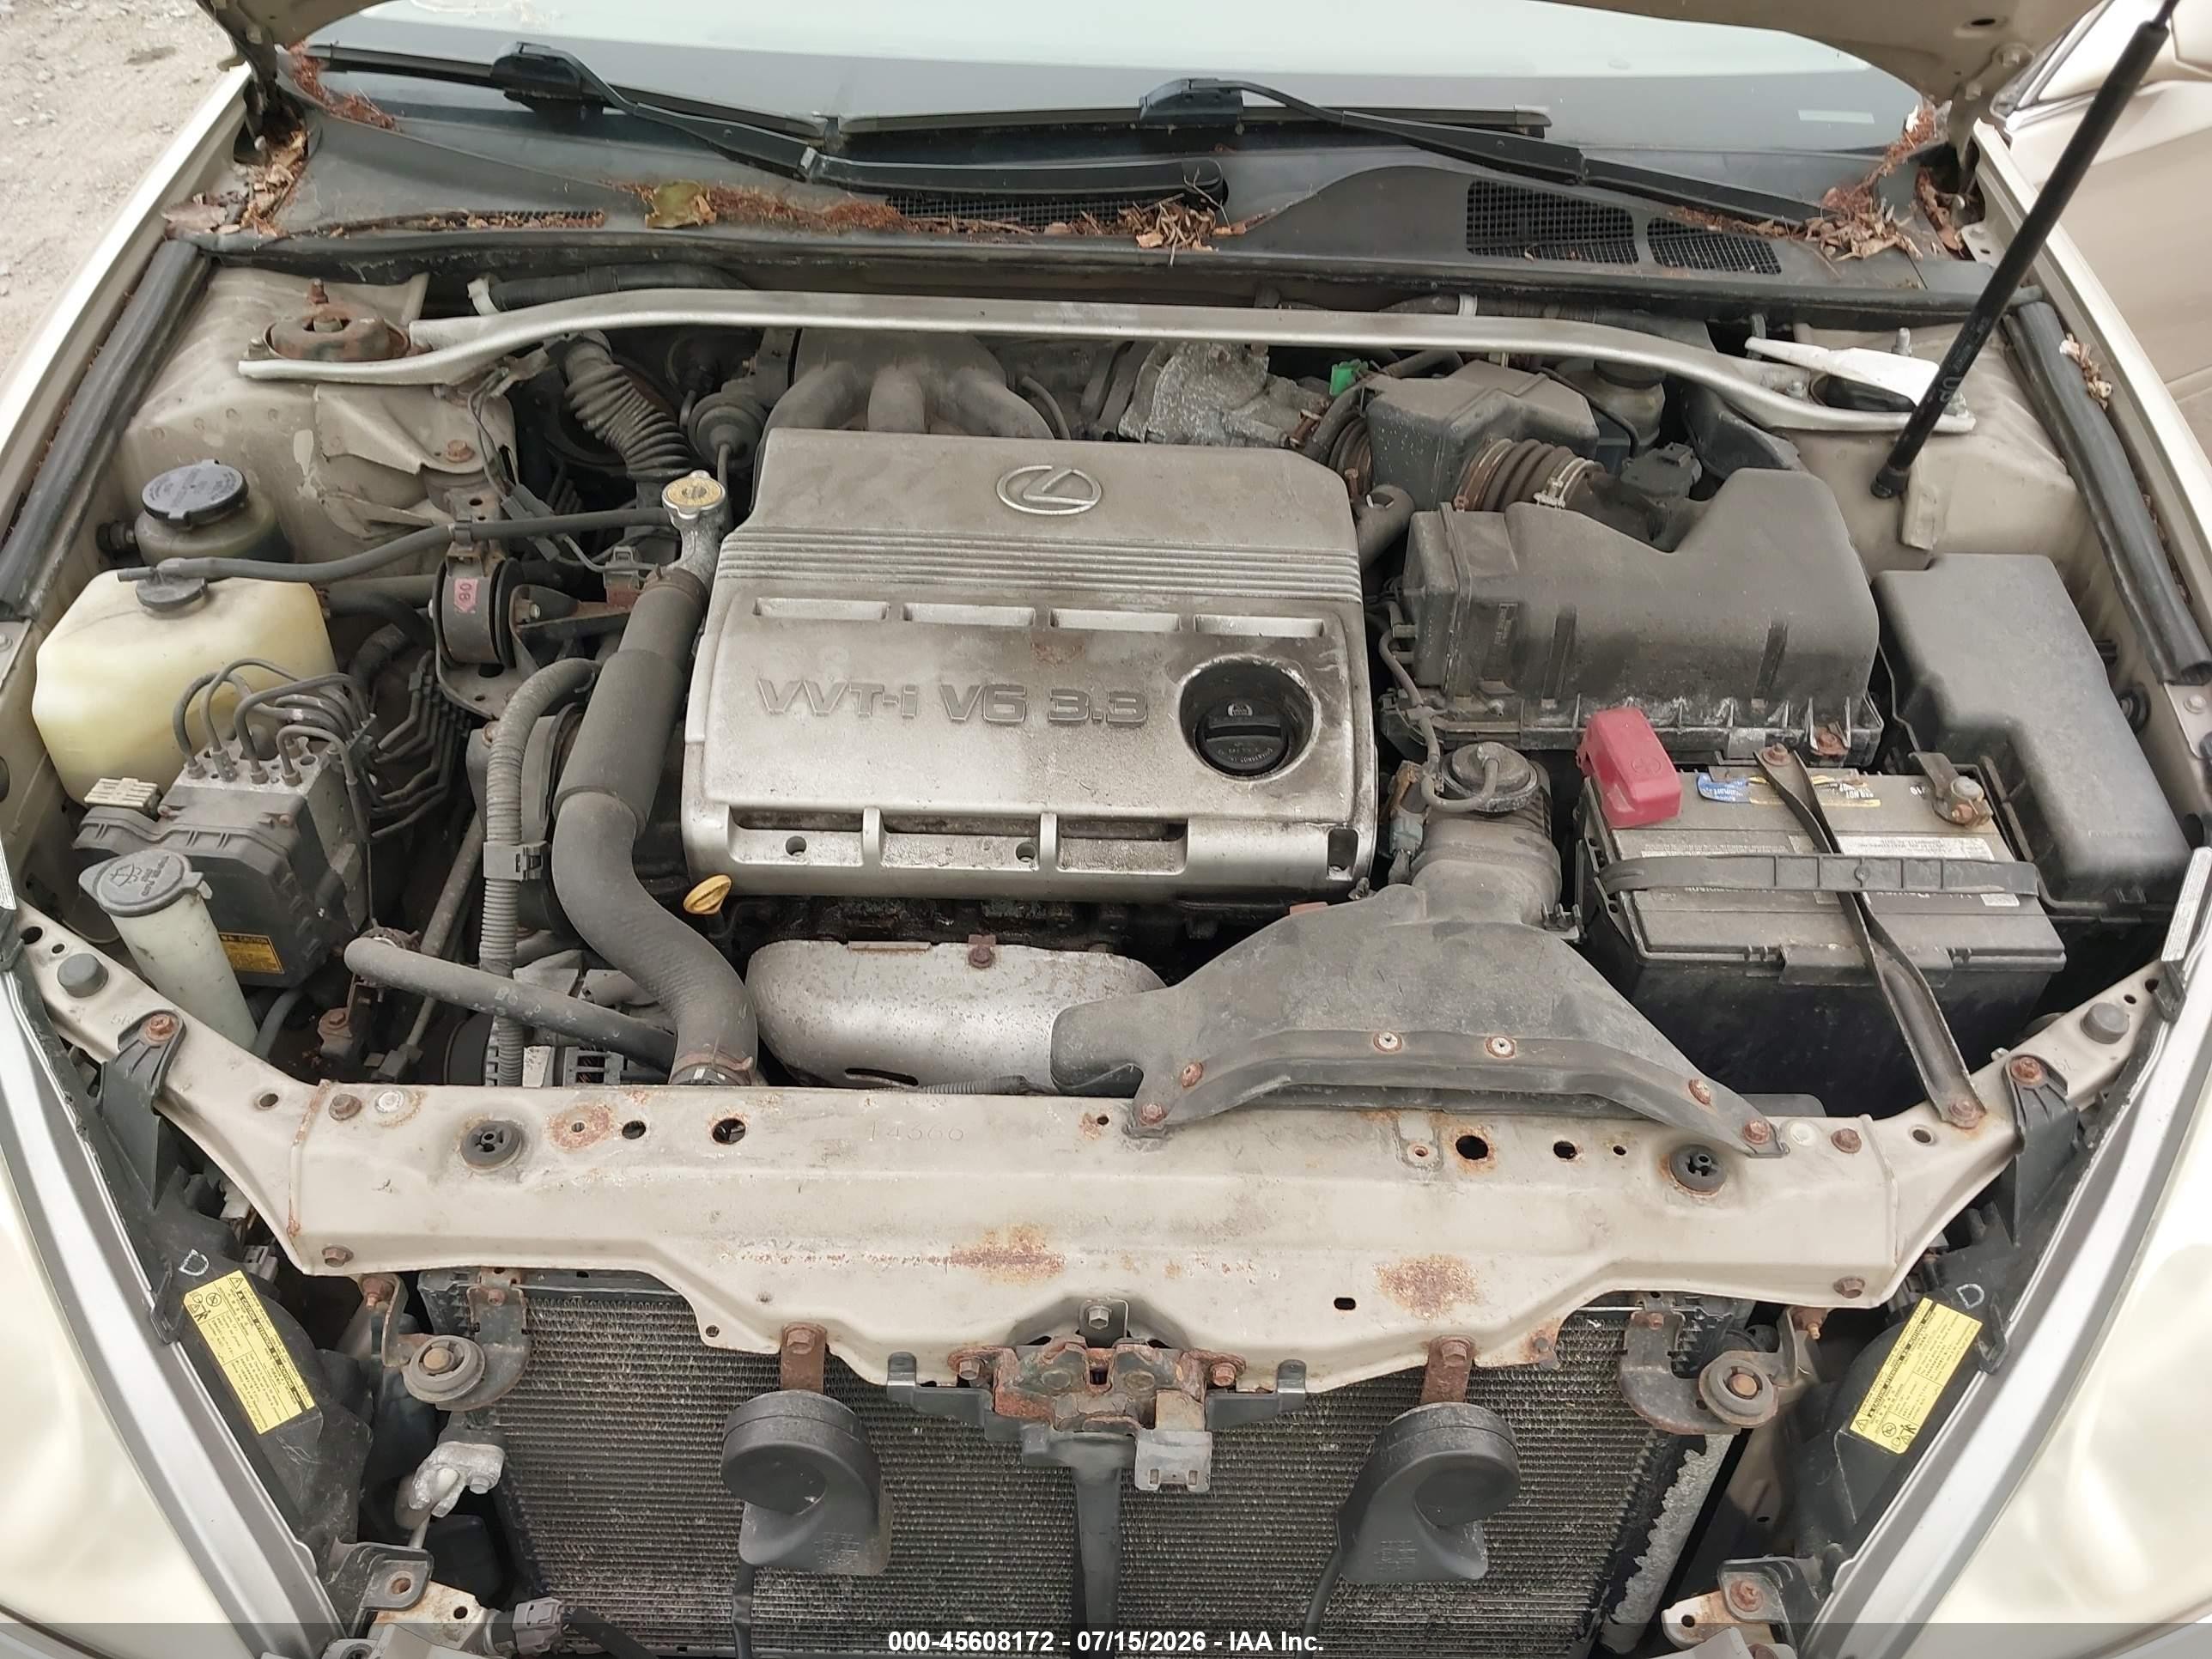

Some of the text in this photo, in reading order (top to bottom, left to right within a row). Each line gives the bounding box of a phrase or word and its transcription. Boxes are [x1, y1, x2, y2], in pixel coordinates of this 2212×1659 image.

[757, 678, 1149, 727] VVT-i V6 3.3
